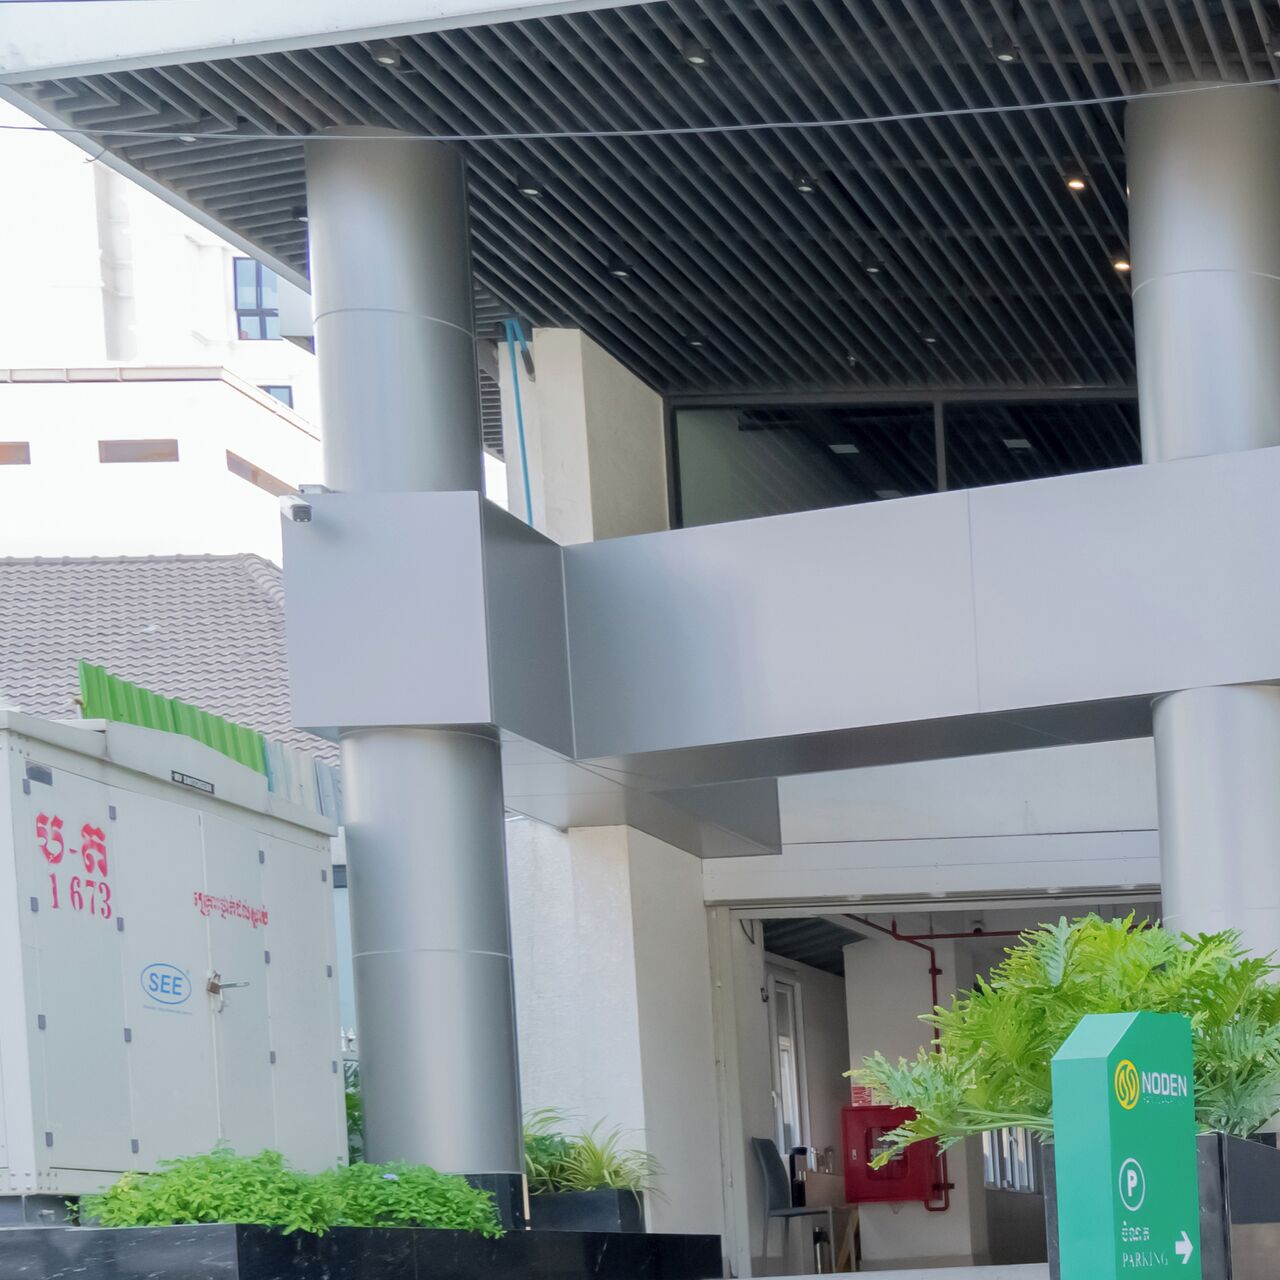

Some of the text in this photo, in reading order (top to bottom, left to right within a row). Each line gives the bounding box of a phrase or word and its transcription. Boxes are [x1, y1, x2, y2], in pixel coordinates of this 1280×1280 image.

[49, 873, 112, 920] 1673
[148, 972, 183, 996] SEE
[1142, 1071, 1187, 1097] NODEN
[1127, 1169, 1138, 1197] P
[1122, 1251, 1169, 1268] PARKING
